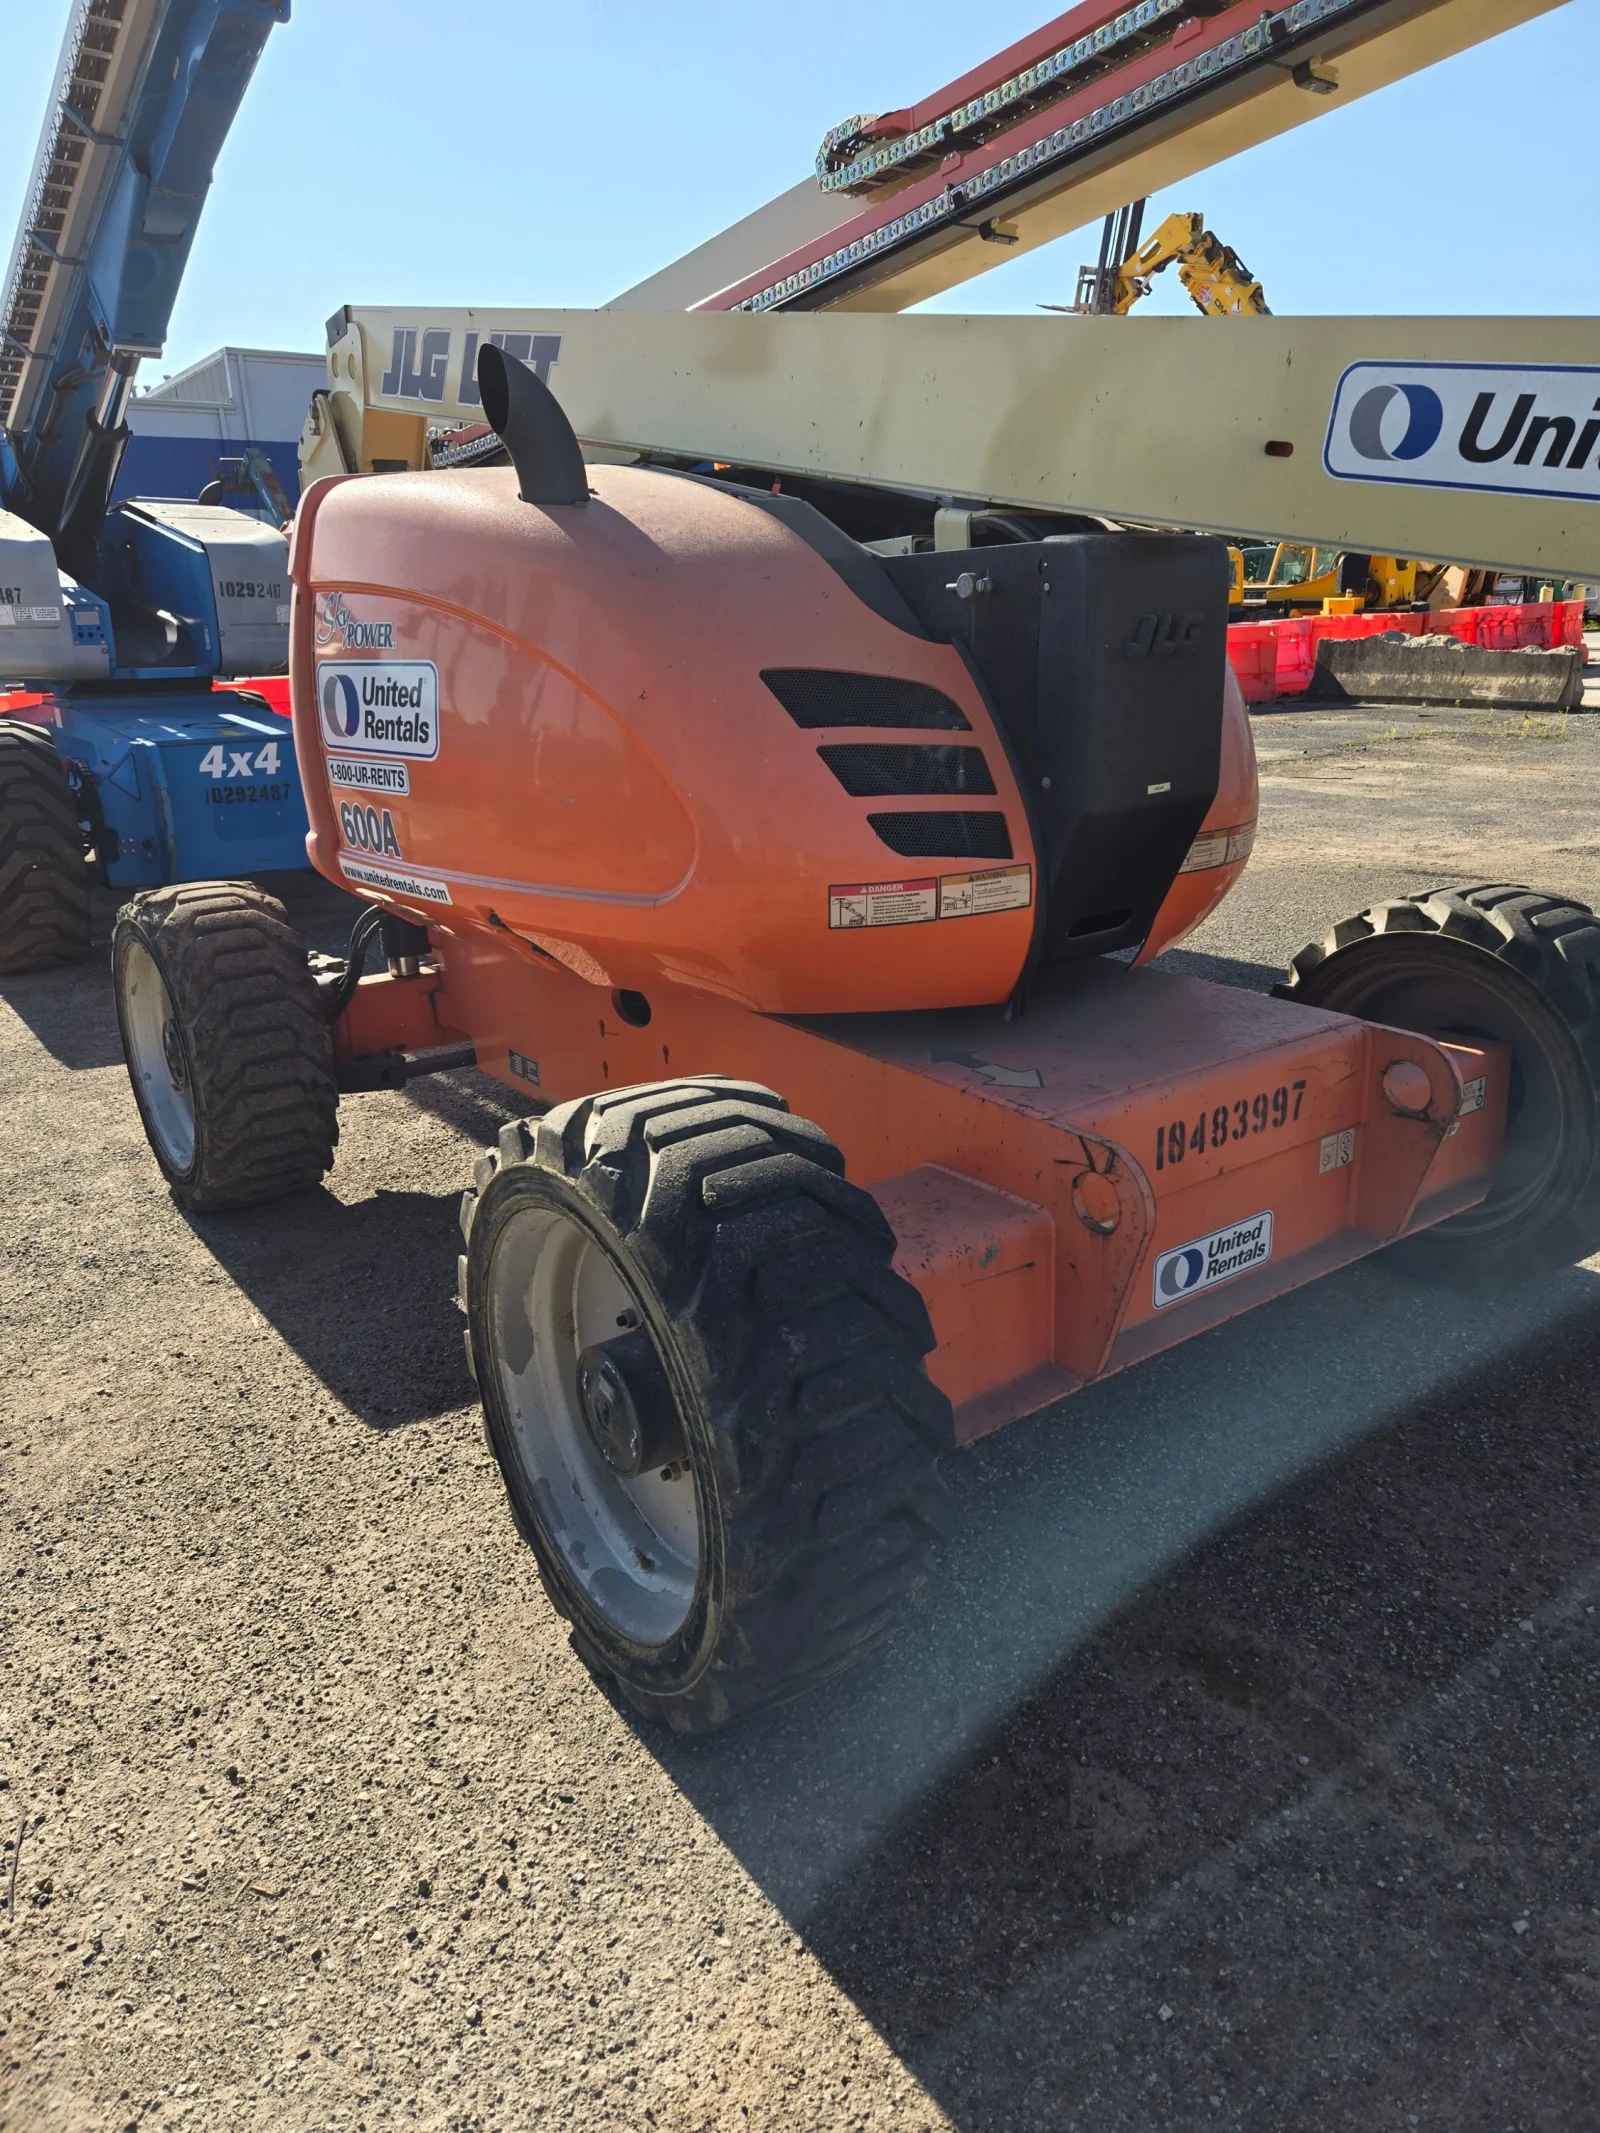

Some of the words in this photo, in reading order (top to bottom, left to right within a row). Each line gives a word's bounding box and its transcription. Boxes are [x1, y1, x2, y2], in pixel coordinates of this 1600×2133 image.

[381, 327, 451, 403] JLG
[1458, 391, 1600, 469] Uni
[347, 622, 394, 649] POWER
[362, 676, 424, 708] United
[364, 710, 430, 743] Rentals
[199, 742, 281, 778] 4x4
[330, 763, 406, 788] 1-800-UR-RENTS
[340, 801, 402, 859] 600A
[342, 865, 449, 901] www.unitedrentals.com
[868, 884, 904, 893] DANGER
[974, 869, 1007, 881] WARNING
[1208, 1220, 1264, 1259] United
[1206, 1241, 1266, 1280] Rentals
